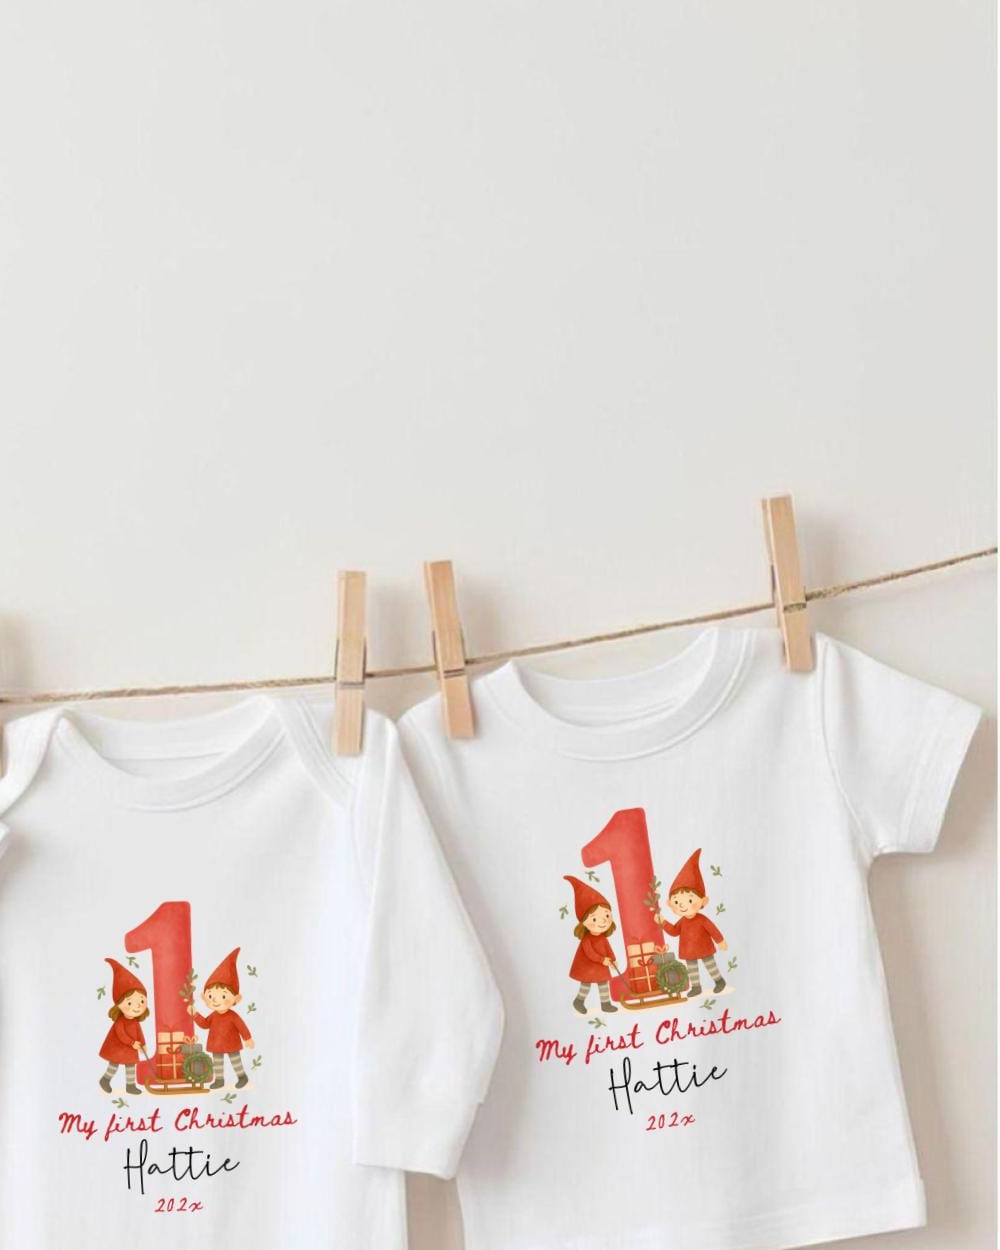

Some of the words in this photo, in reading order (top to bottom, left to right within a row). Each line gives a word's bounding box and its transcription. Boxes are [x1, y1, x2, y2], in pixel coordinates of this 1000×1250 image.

[581, 807, 689, 1001] 1
[125, 901, 212, 1085] 1
[535, 1039, 578, 1066] My
[584, 1023, 643, 1065] first
[654, 1008, 782, 1045] Christmas
[608, 1056, 728, 1115] Hattie
[58, 1111, 97, 1141] My
[103, 1108, 163, 1142] first
[173, 1103, 297, 1133] Christmas
[645, 1112, 696, 1132] 202x
[123, 1138, 241, 1195] Hattie
[155, 1197, 204, 1213] 202x
